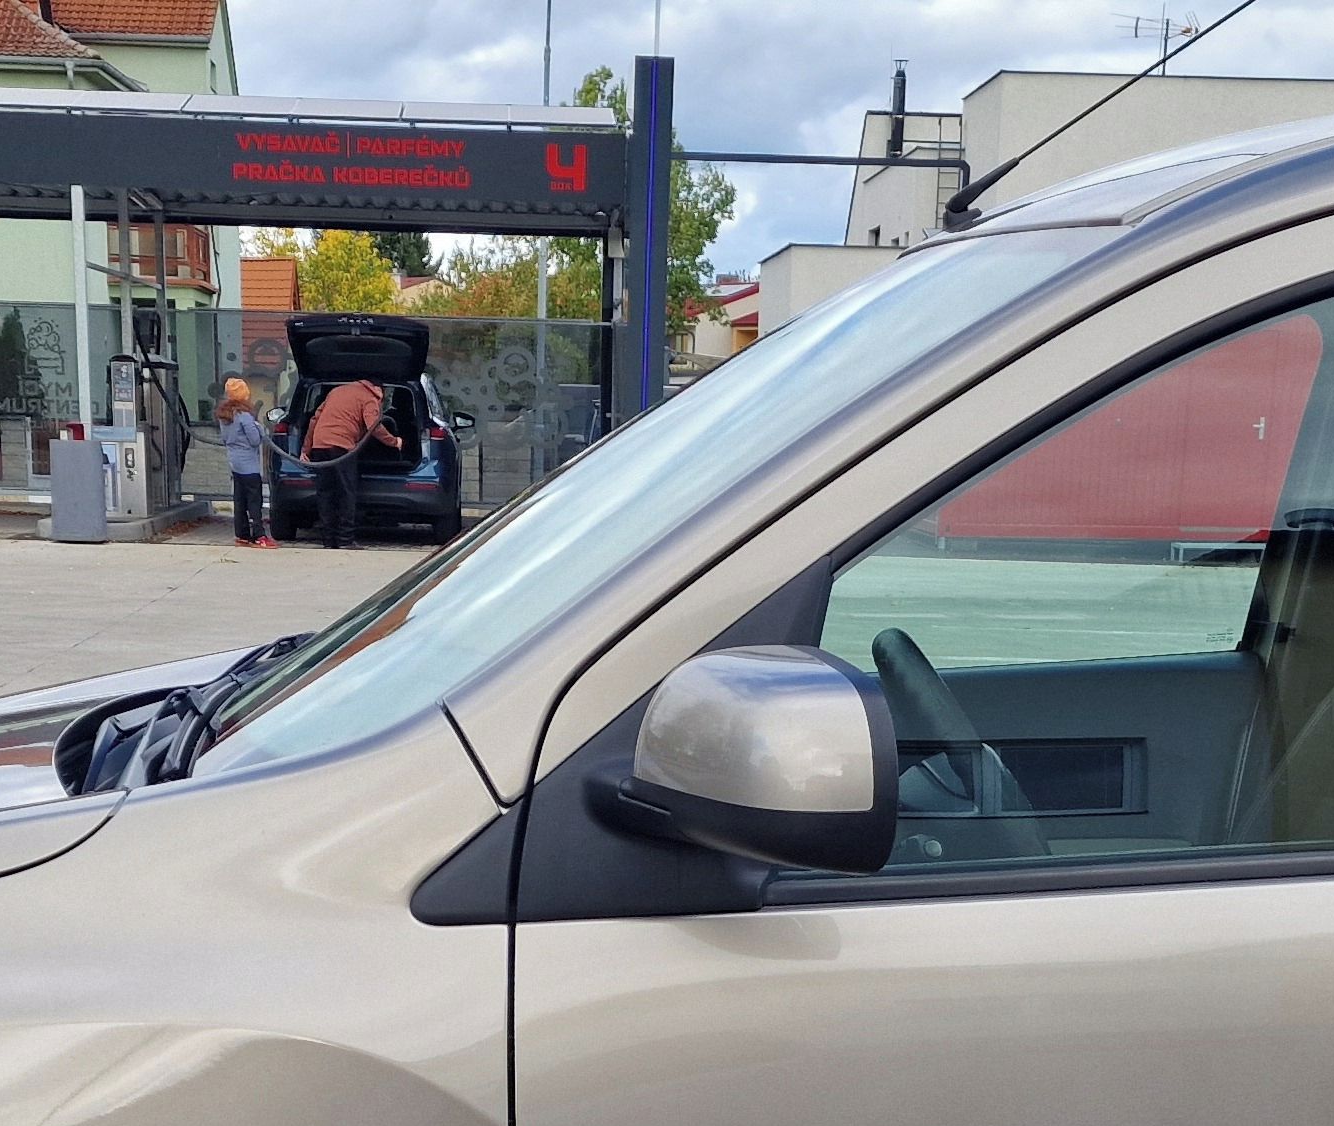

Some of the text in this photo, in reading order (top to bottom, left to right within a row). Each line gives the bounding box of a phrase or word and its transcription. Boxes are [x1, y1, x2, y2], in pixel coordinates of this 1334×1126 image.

[236, 131, 465, 158] VYSAVAČ PARFÉMY
[233, 159, 472, 189] PRAČKA KOBEREČKŮ
